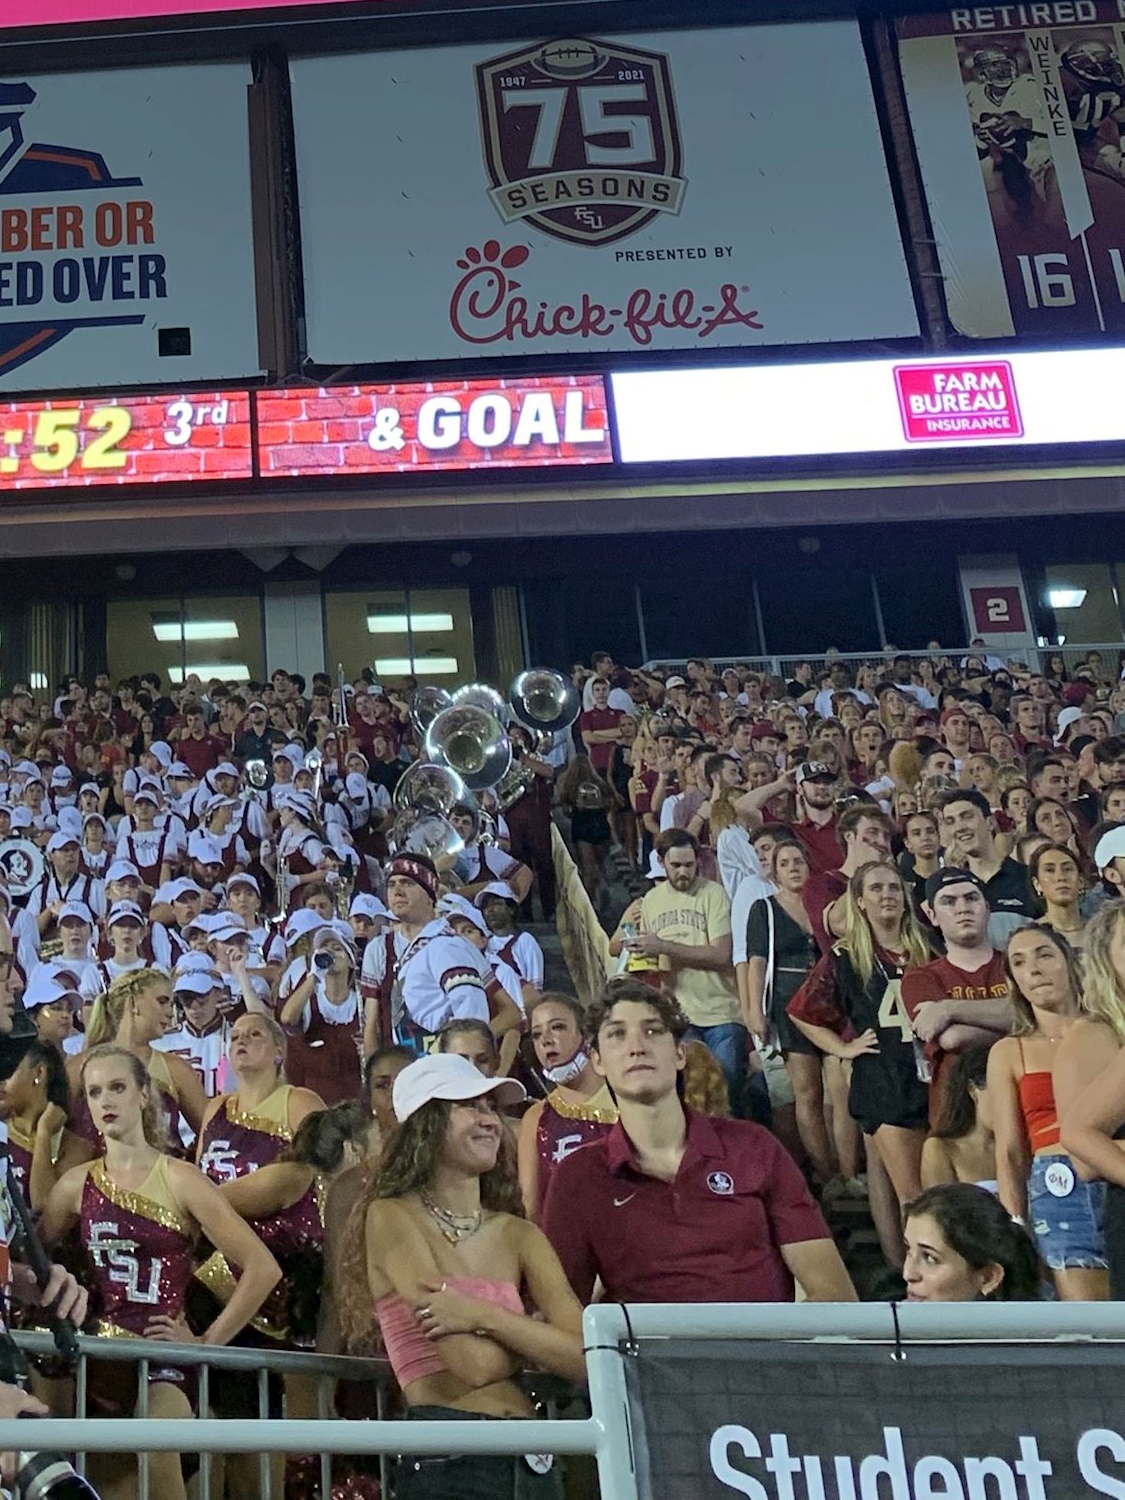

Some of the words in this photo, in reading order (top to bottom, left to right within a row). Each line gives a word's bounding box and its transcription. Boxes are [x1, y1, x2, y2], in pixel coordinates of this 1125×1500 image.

[951, 0, 1098, 31] RETIRED
[500, 76, 526, 88] 1947
[618, 69, 645, 81] 2021
[1029, 36, 1067, 137] WEINKE
[502, 83, 657, 169] 75
[507, 176, 672, 210] SEASONS
[94, 200, 155, 248] OR
[573, 206, 604, 230] FSU
[615, 247, 707, 263] PRESENTED
[714, 246, 734, 259] BY
[52, 253, 168, 302] OVER
[1017, 253, 1076, 309] 16
[931, 372, 1004, 393] FARM
[909, 392, 1007, 415] BUREAU
[164, 401, 229, 445] 3rd
[369, 407, 406, 451] &
[415, 391, 604, 449] GOAL
[925, 414, 1010, 432] INSURANCE
[987, 598, 1009, 622] 2
[87, 1222, 162, 1305] FSU
